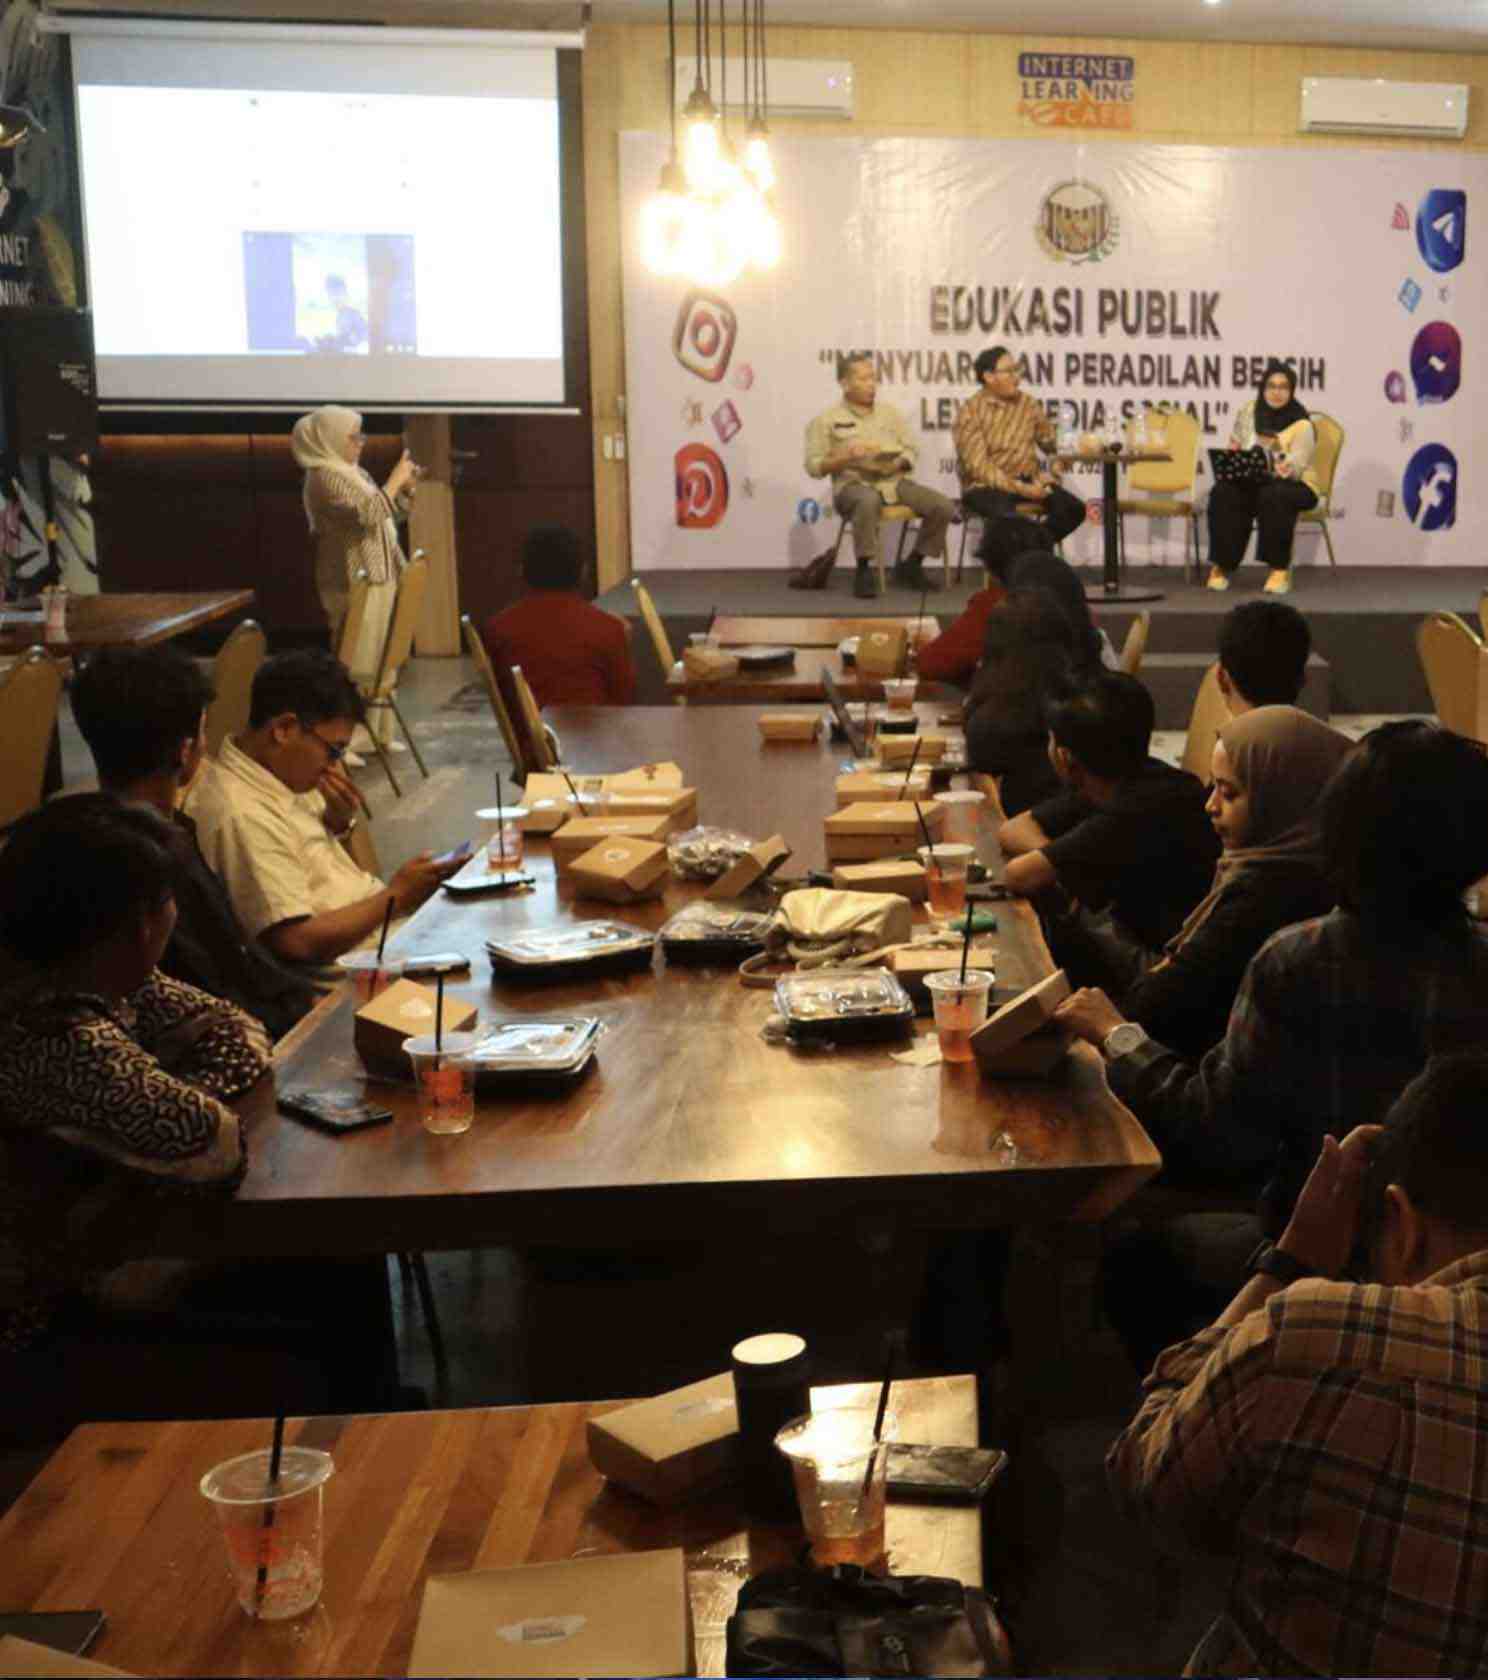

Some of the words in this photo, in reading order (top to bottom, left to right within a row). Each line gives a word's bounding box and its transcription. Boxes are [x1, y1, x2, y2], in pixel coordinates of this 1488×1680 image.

[1023, 55, 1128, 79] INTERNET
[930, 286, 1083, 336] EDUKASI
[1098, 288, 1222, 339] PUBLIK
[1065, 352, 1221, 388] PERADILAN
